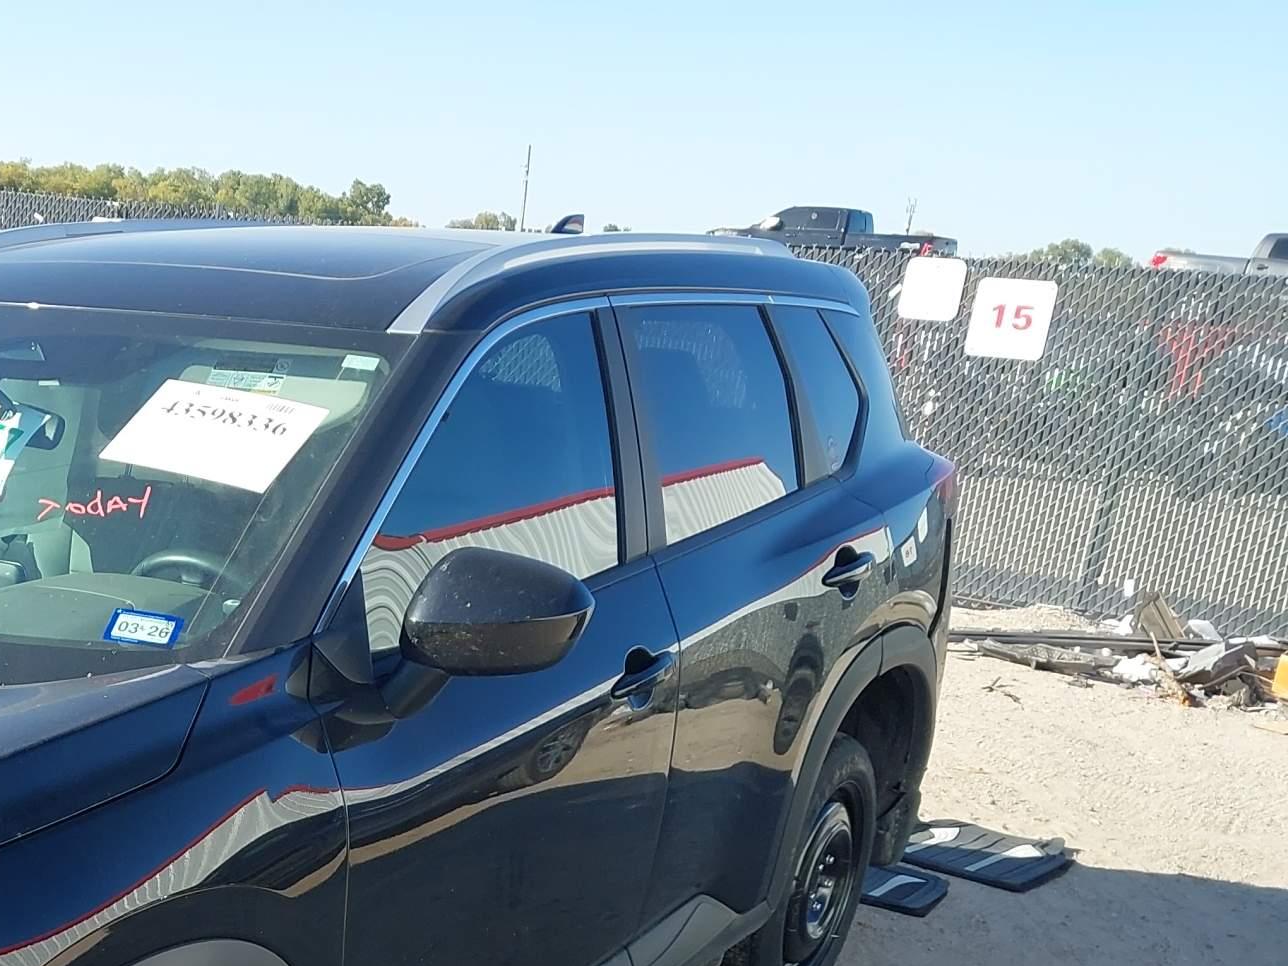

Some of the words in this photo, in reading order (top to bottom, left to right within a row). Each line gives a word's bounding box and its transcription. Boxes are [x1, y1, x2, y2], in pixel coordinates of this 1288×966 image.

[992, 304, 1034, 331] 15
[161, 399, 288, 437] 43598336
[118, 620, 140, 634] 03
[147, 625, 171, 638] 26
